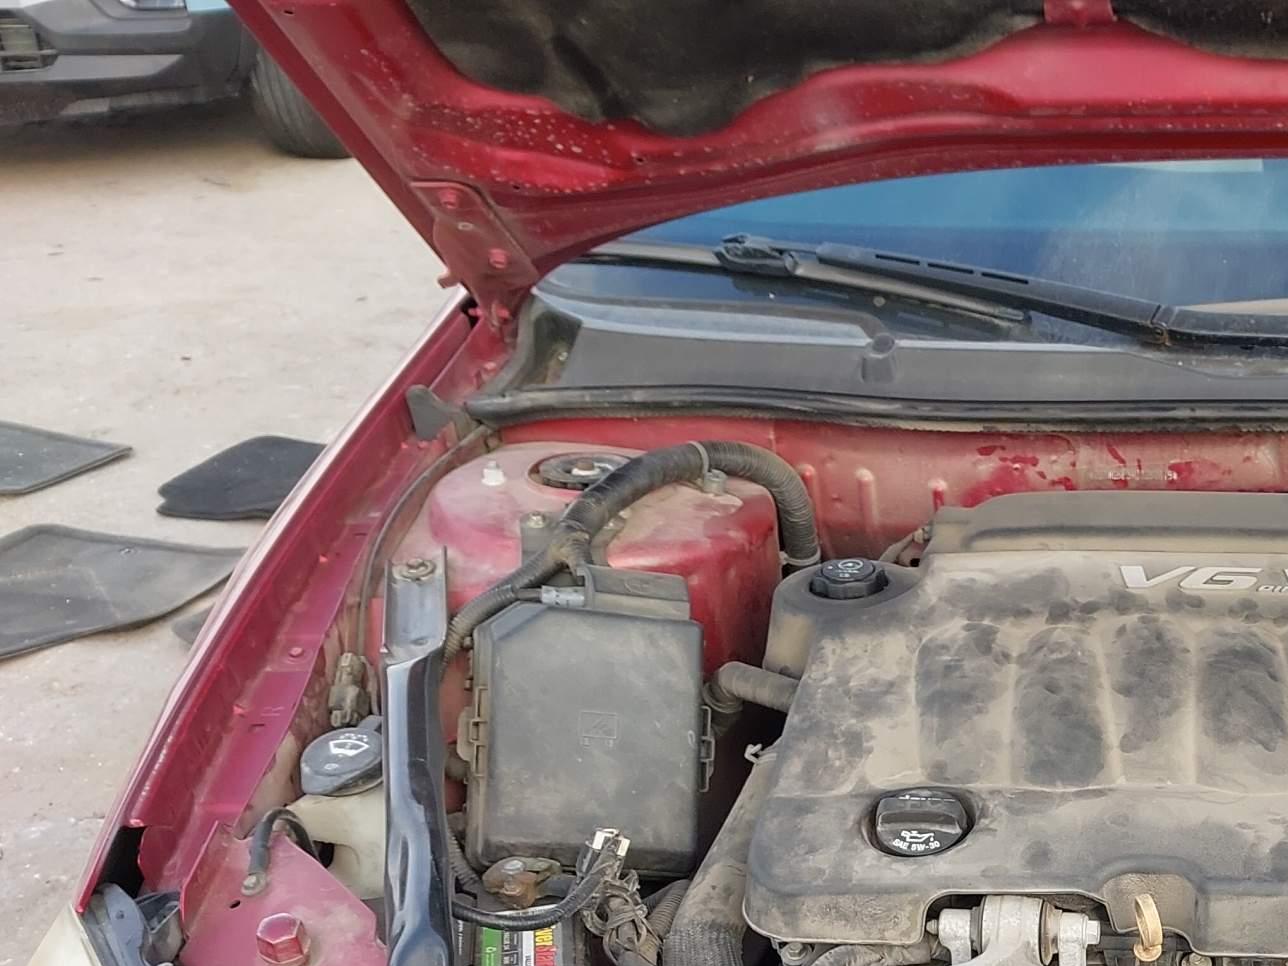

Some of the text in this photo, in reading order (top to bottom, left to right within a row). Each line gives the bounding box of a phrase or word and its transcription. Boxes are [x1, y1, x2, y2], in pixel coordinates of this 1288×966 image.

[1119, 565, 1263, 591] V6
[893, 839, 940, 851] SAE 5W-30
